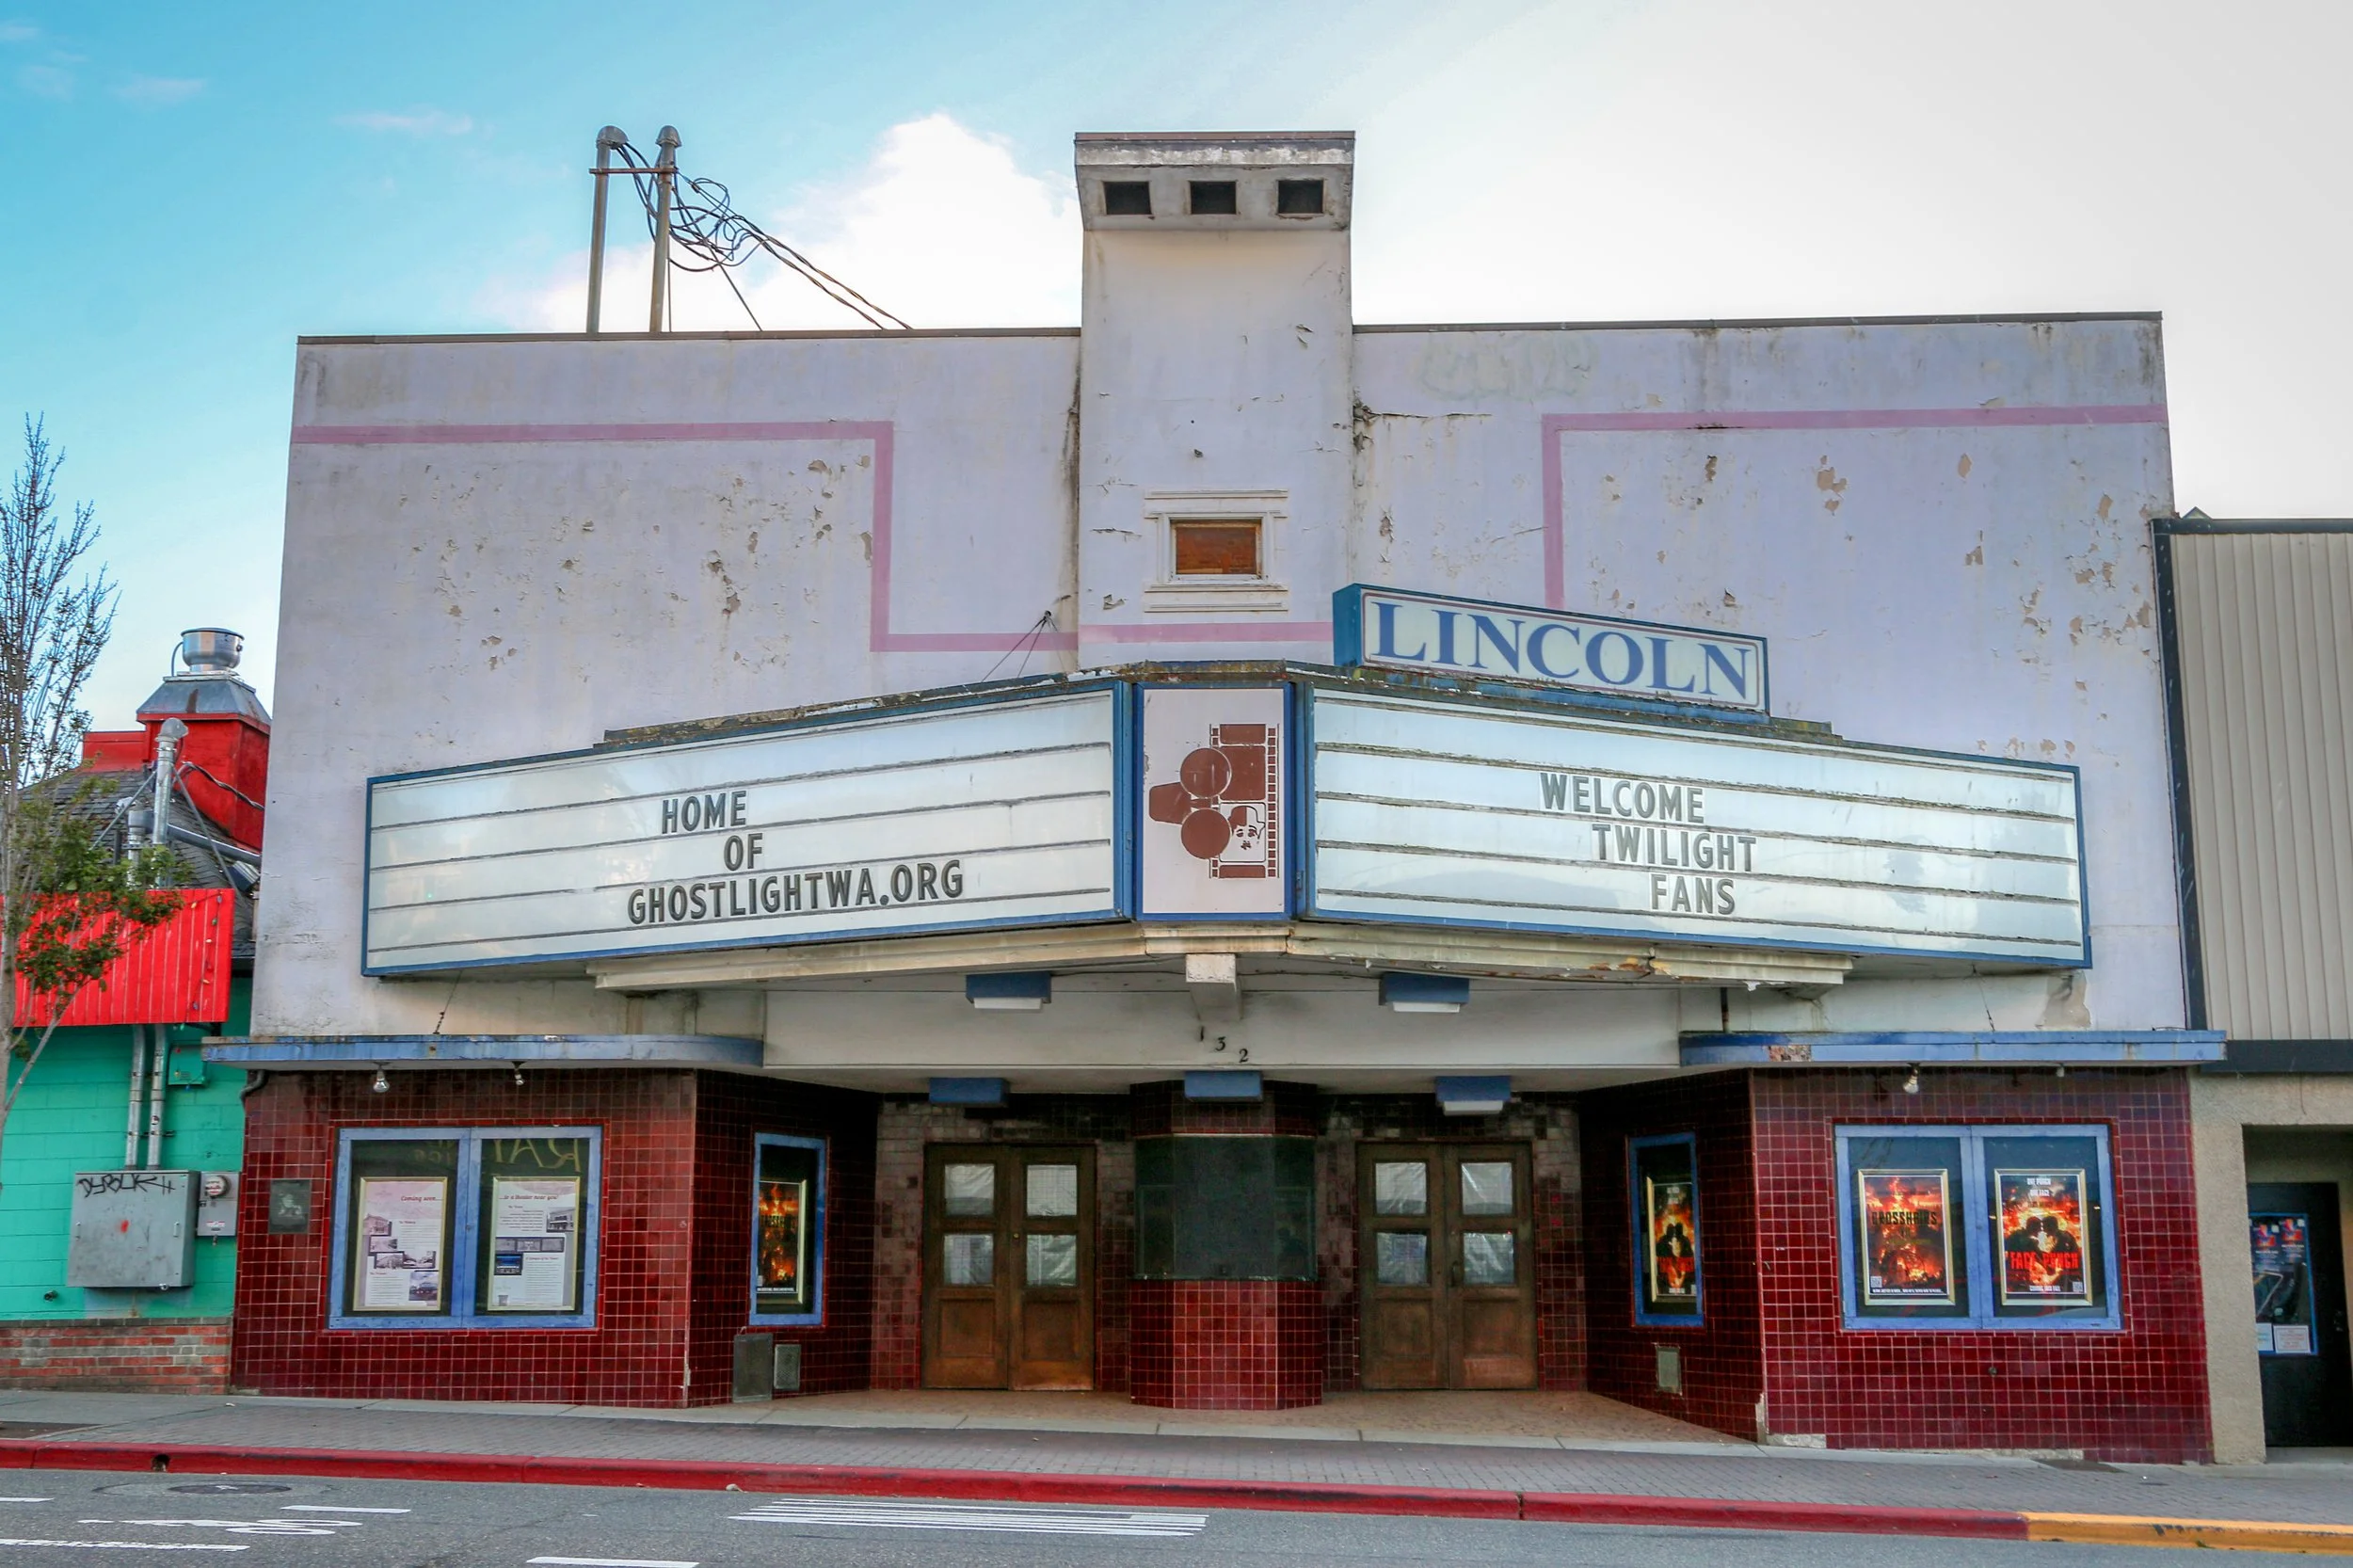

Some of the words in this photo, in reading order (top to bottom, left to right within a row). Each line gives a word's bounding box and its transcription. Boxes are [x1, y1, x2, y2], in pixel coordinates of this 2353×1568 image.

[1371, 601, 1752, 700] LINCOLN
[661, 791, 747, 835] HOME
[1540, 773, 1705, 824] WELCOME
[723, 833, 763, 872] OF
[1592, 824, 1757, 872] TWILIGHT
[628, 859, 964, 925] GHOSTLIGHTWA.ORG
[1650, 873, 1736, 916] FANS
